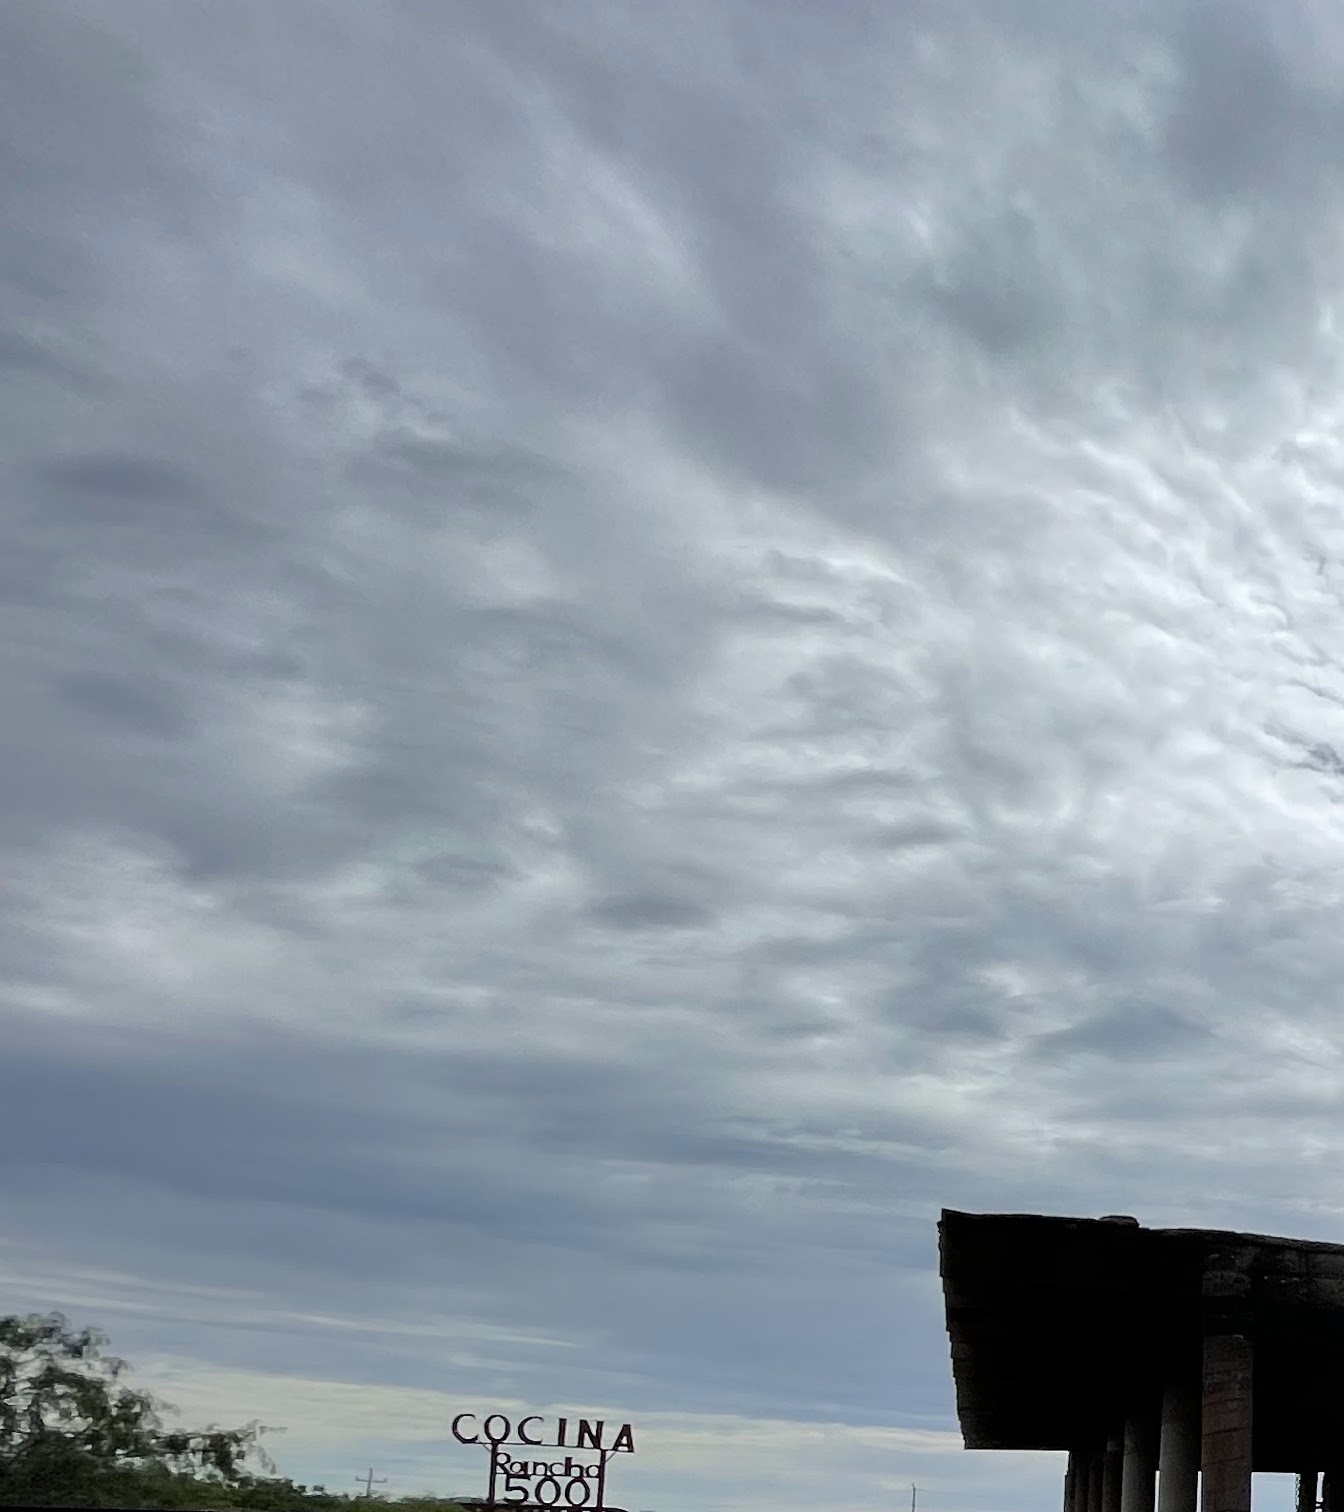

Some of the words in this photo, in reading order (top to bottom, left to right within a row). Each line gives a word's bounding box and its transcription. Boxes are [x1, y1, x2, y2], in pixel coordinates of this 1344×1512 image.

[452, 1413, 634, 1453] COCINA
[496, 1452, 600, 1479] Rancho
[504, 1474, 590, 1507] 500
